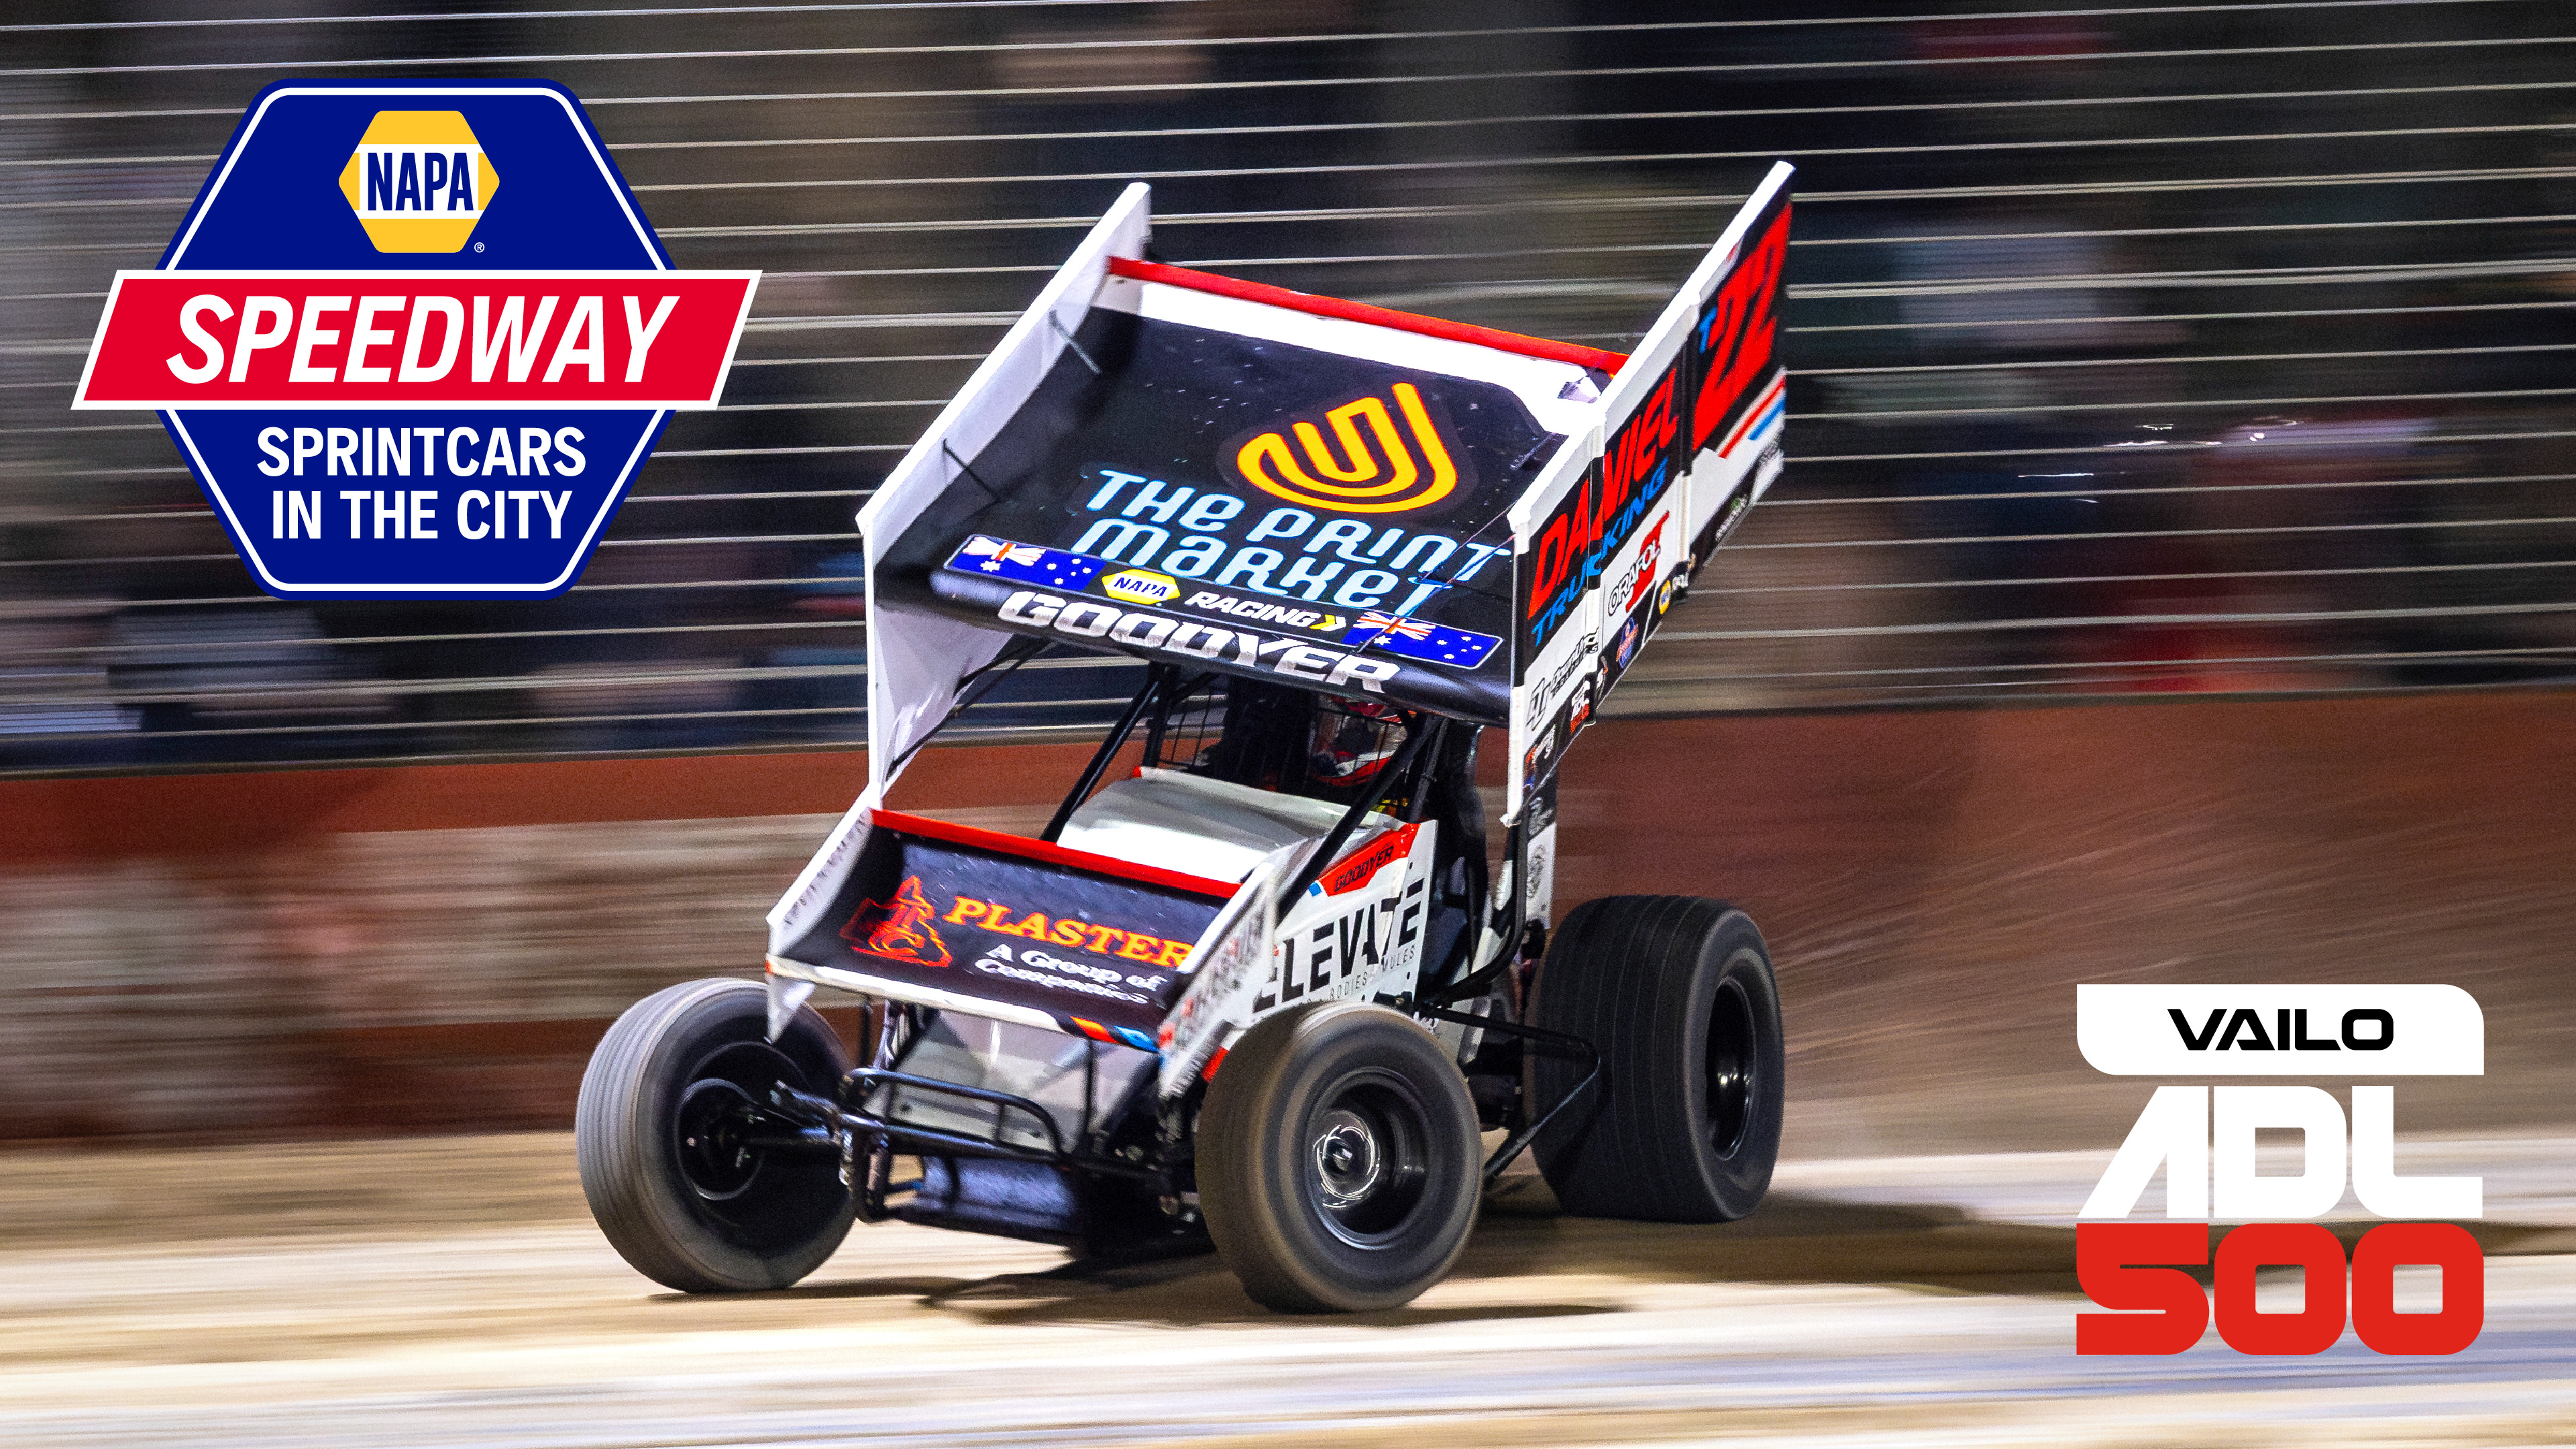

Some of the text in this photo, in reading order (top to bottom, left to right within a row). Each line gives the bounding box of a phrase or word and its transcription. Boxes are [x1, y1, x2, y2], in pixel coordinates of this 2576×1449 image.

[1527, 368, 1680, 620] DANIEL
[1532, 456, 1668, 648] TRUCKING
[1607, 537, 1662, 617] ORAFOL
[1113, 576, 1322, 628] NAPA RACING
[998, 591, 1402, 694] GOODYER
[1334, 845, 1394, 893] GOODYER
[942, 896, 1195, 969] PLASTER
[983, 943, 1169, 991] A Group of
[973, 957, 1150, 1004] Companies
